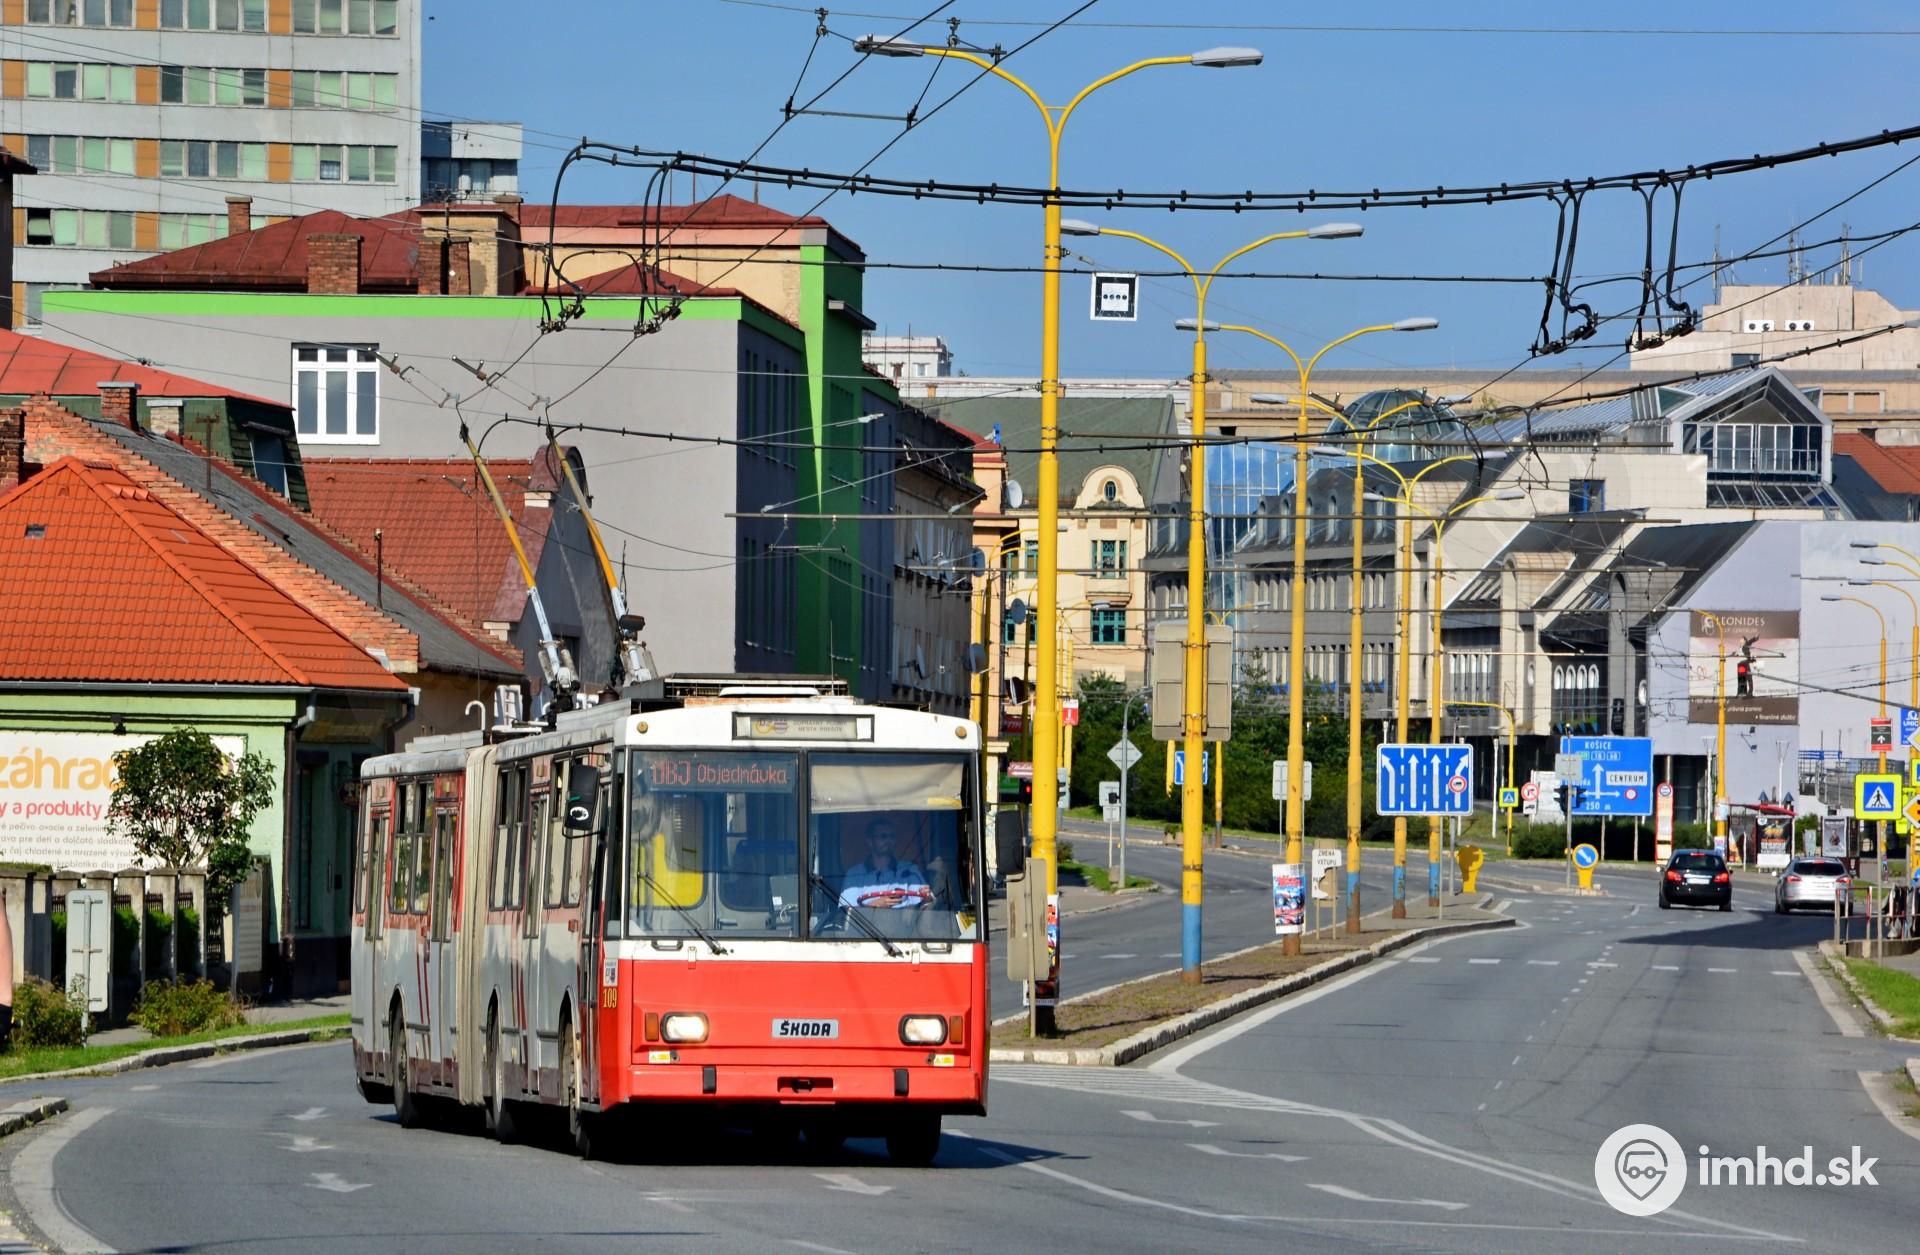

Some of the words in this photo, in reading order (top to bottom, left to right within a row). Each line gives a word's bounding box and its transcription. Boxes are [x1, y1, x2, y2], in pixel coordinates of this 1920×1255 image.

[1584, 740, 1612, 750] KOŠICE
[697, 761, 787, 785] Objednávka
[1609, 774, 1644, 784] CENTRUM
[12, 802, 22, 815] a
[26, 800, 102, 821] produkty
[1585, 801, 1601, 810] 250
[602, 987, 618, 1009] 109
[779, 1019, 832, 1037] ŠKODA
